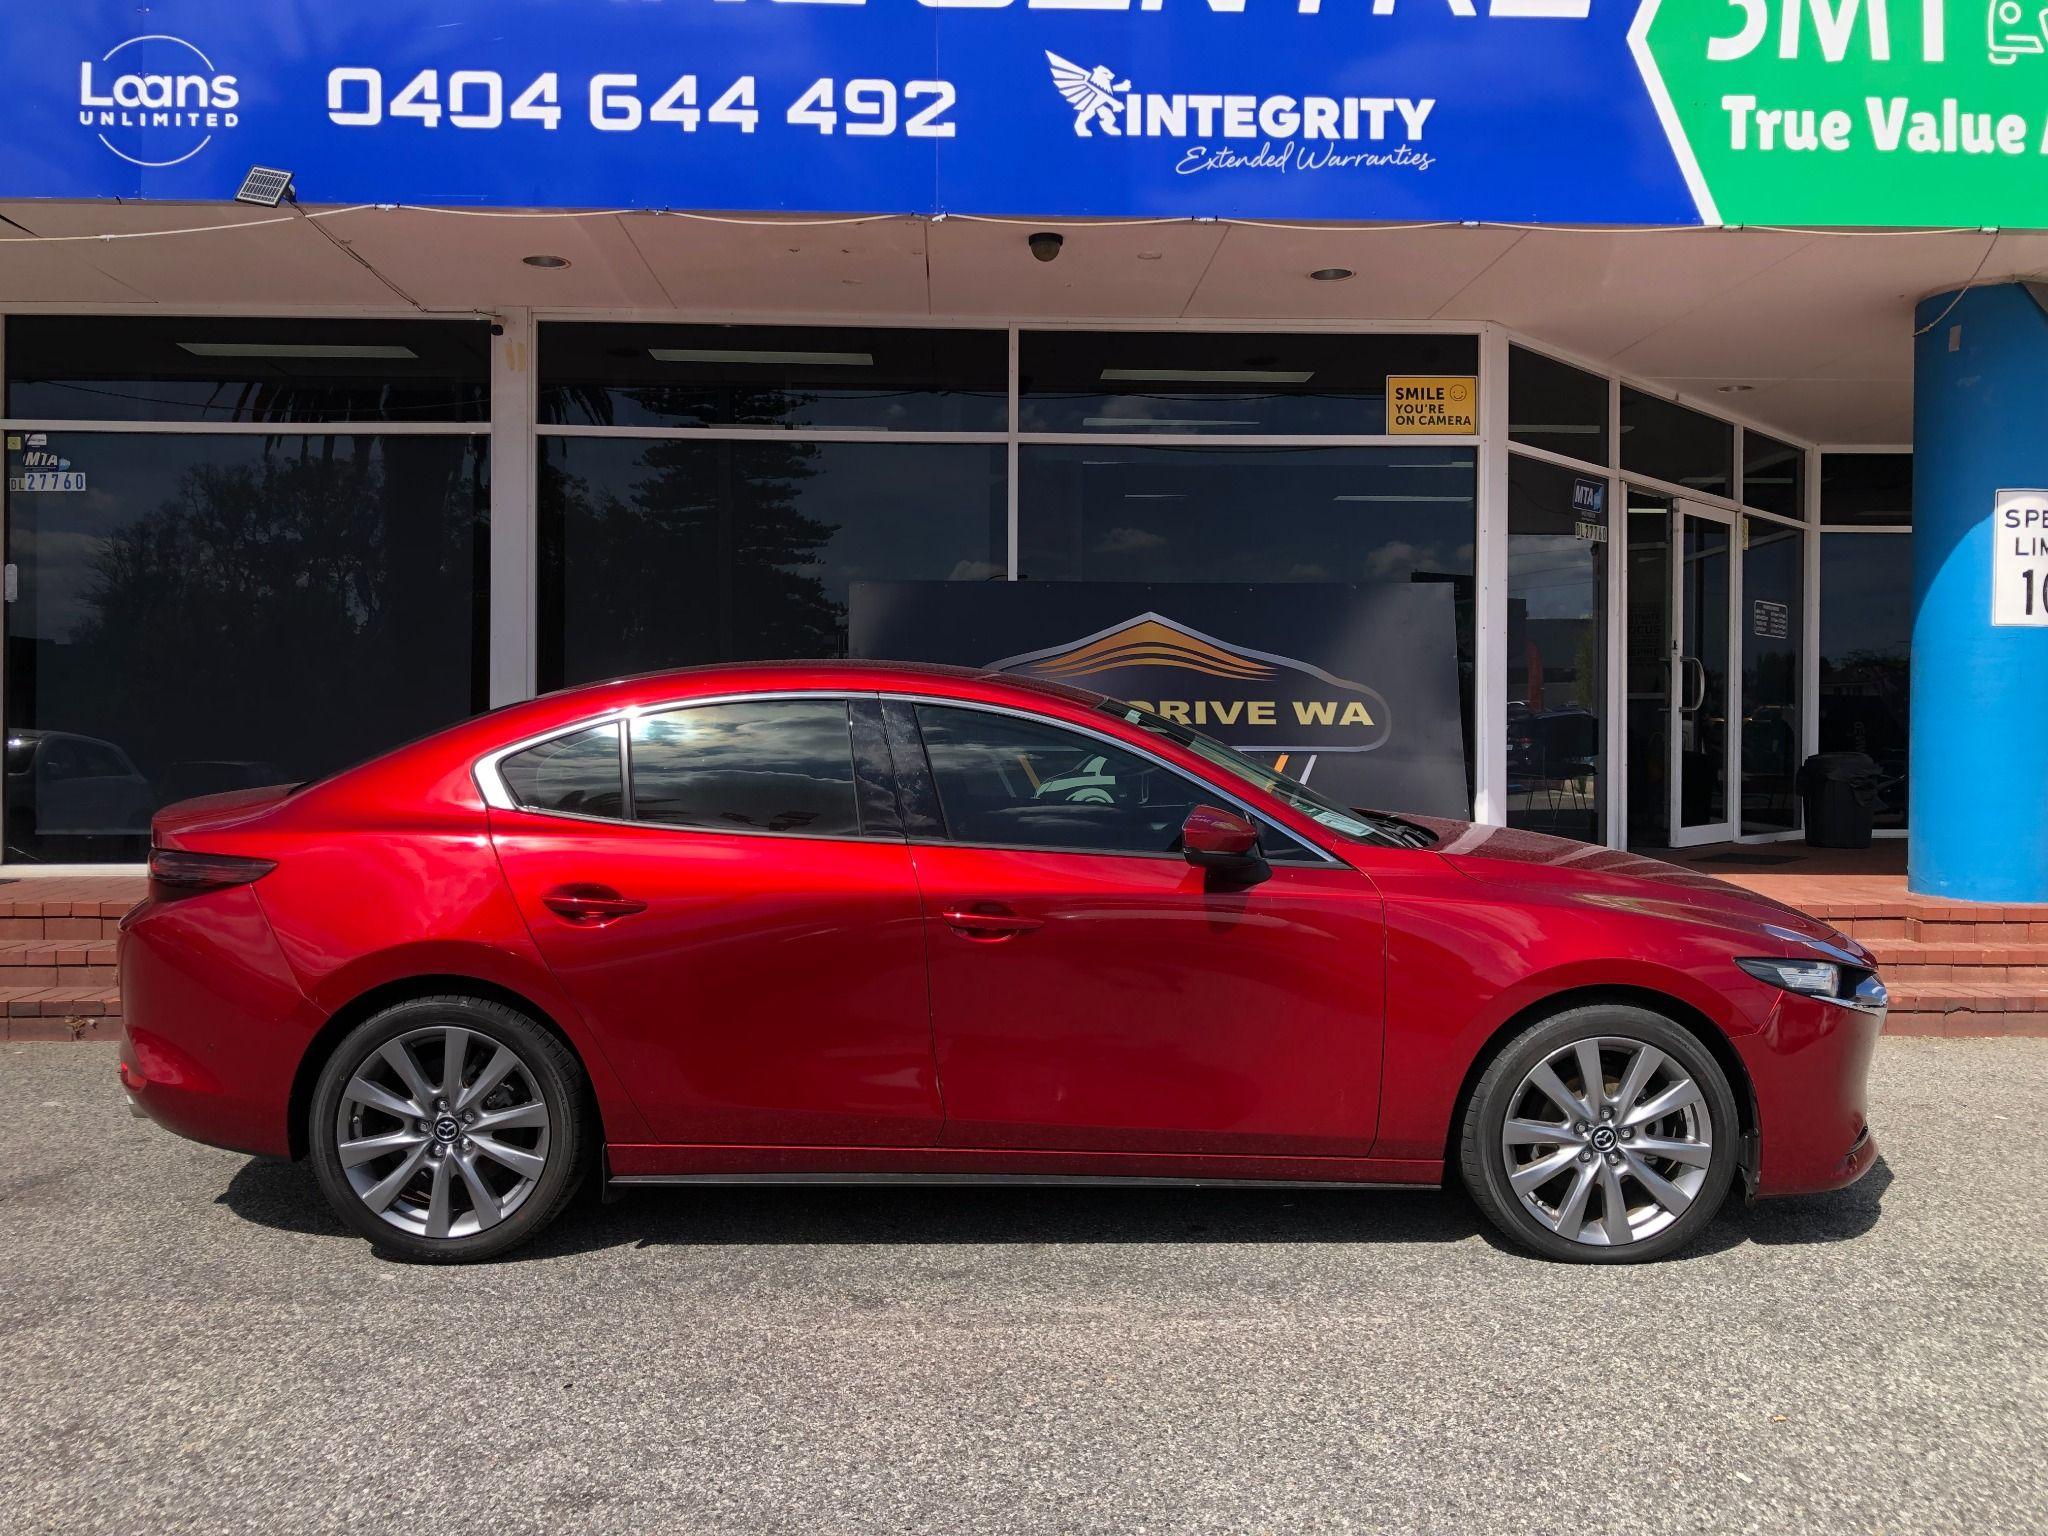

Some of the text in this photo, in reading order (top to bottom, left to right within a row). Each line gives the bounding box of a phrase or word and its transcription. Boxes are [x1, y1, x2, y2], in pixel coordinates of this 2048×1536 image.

[80, 61, 240, 108] Loans
[327, 67, 956, 138] 0404 644 492
[79, 111, 239, 127] UNLIMITED
[1126, 93, 1436, 141] INTEGRITY
[1721, 95, 1852, 151] True
[1865, 96, 2022, 155] Value
[1175, 141, 1436, 175] Extended Warranties
[1395, 387, 1445, 400] SMILE
[1395, 403, 1445, 414] YOU'RE
[1395, 415, 1472, 426] ON CAMERA
[25, 451, 58, 466] MTA
[1574, 486, 1594, 506] MTA
[2022, 569, 2048, 616] 1
[1292, 702, 1375, 726] WA
